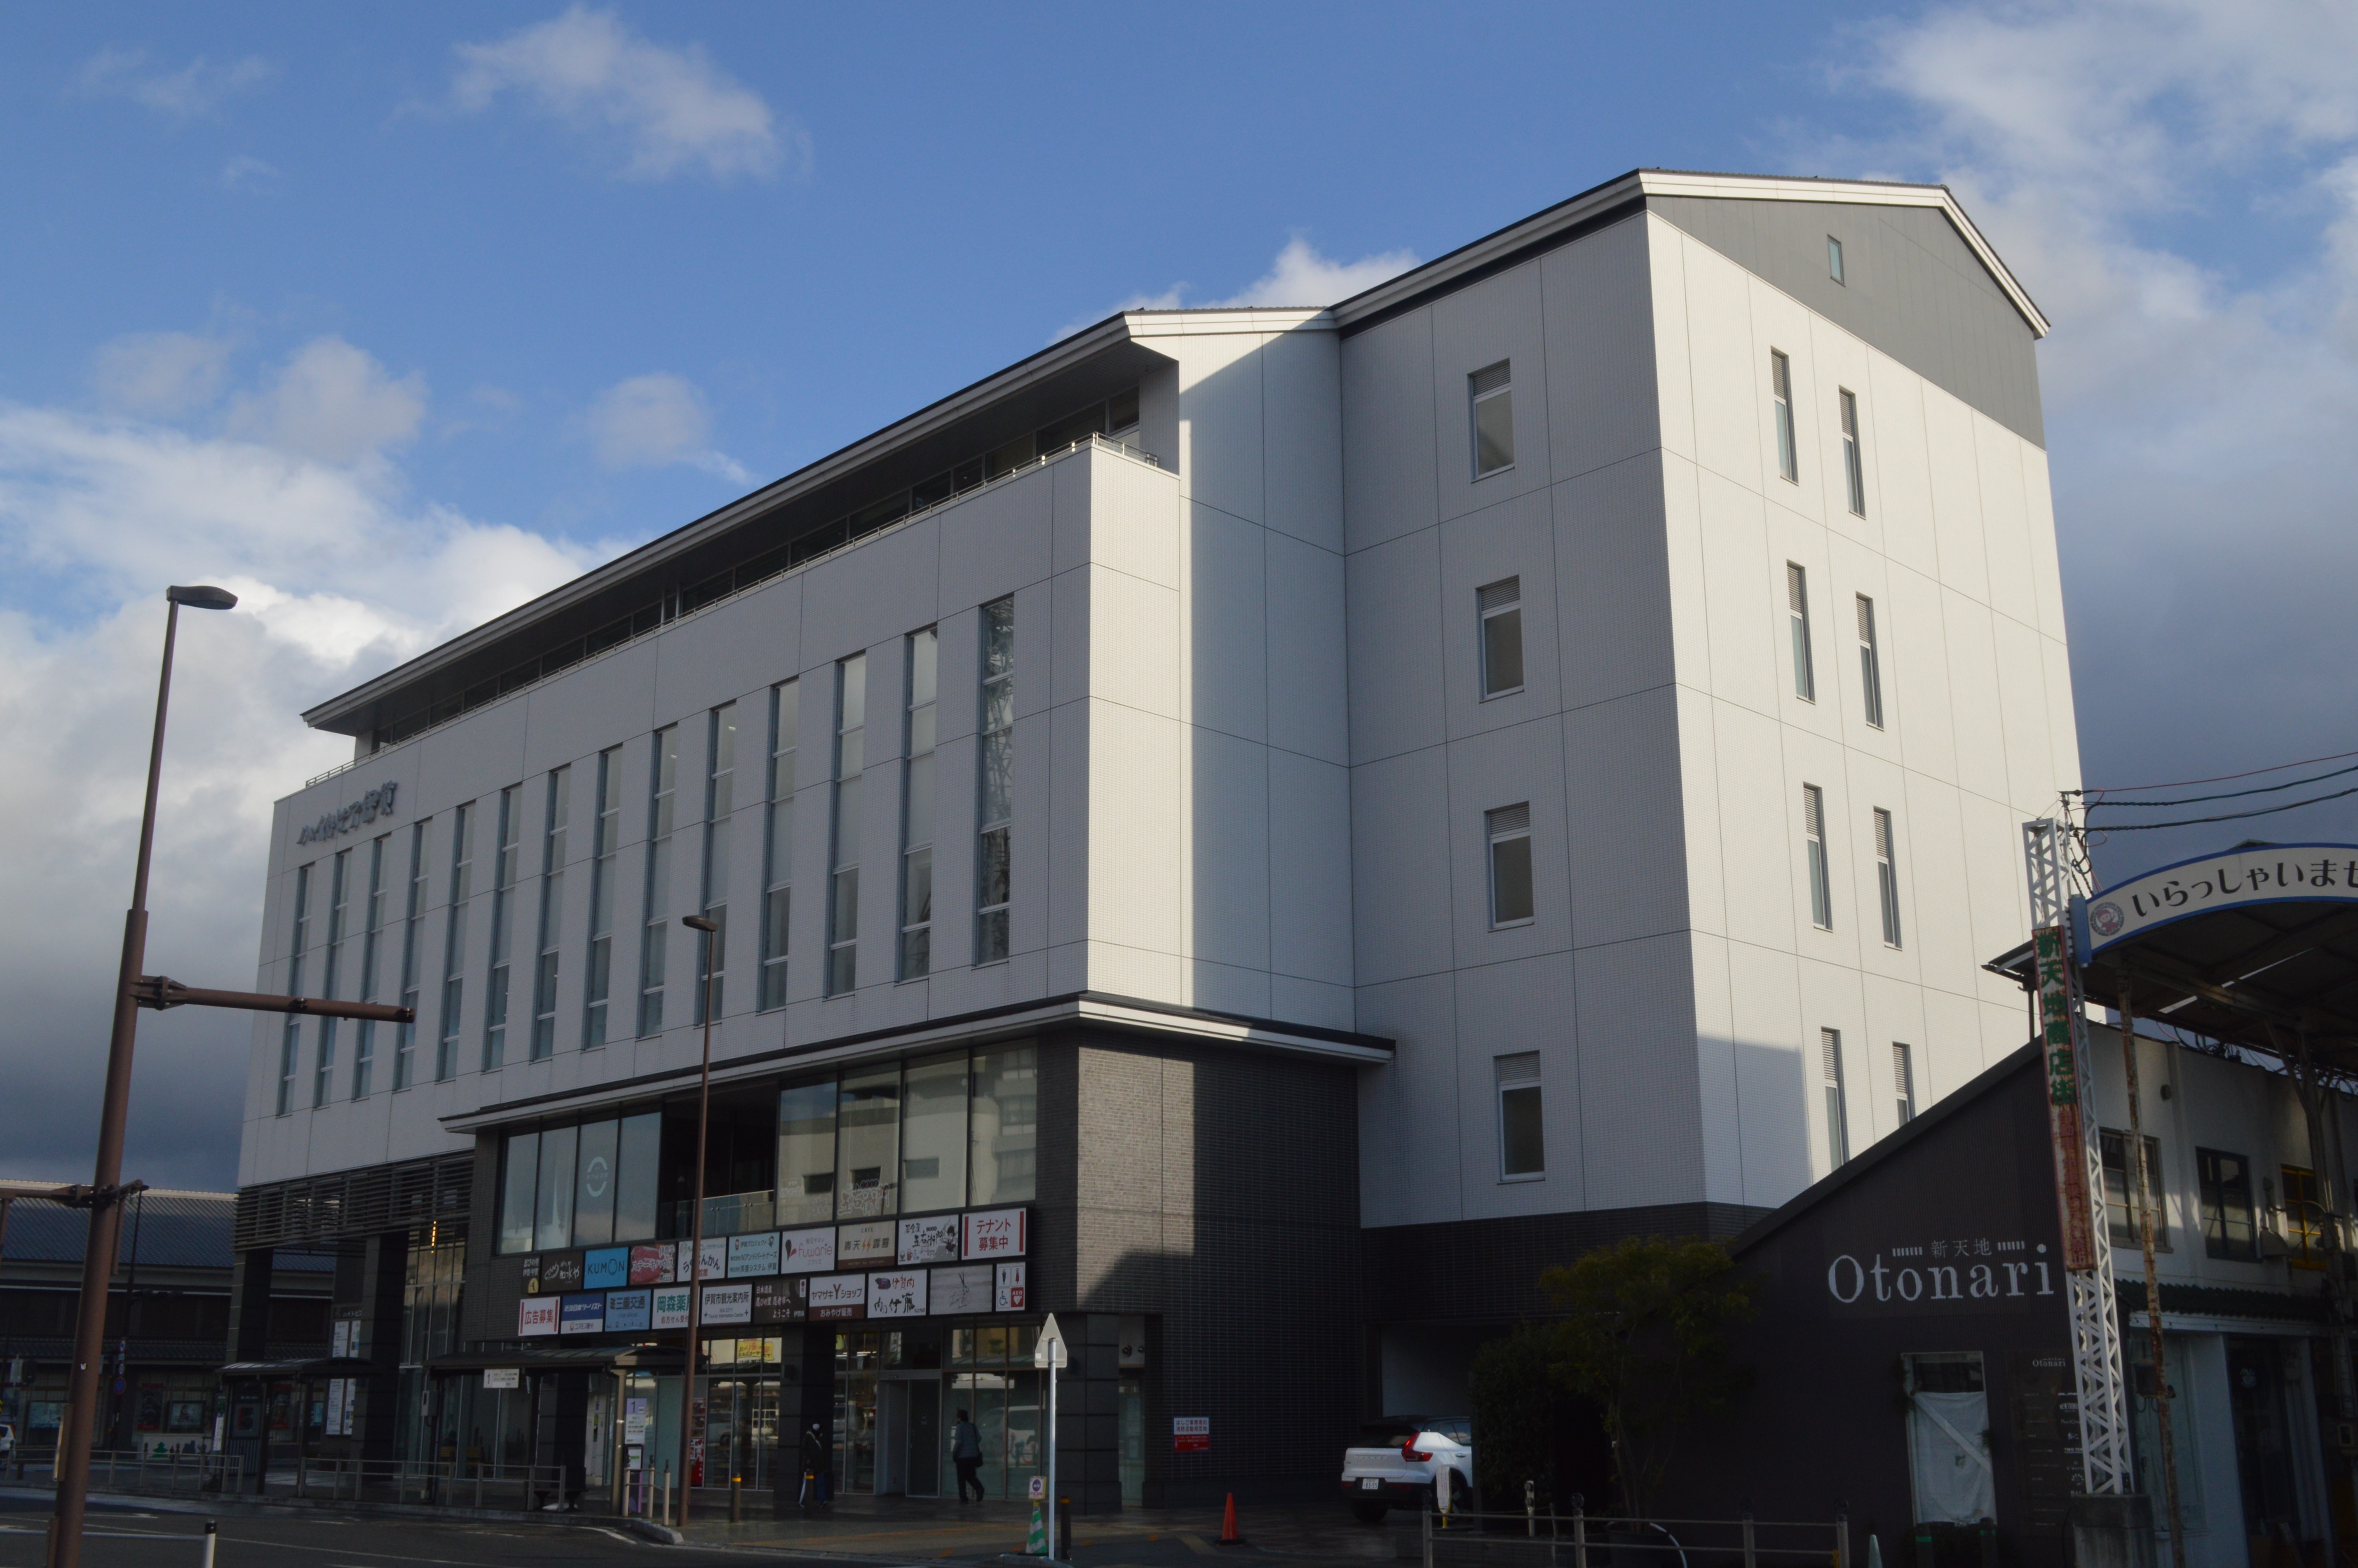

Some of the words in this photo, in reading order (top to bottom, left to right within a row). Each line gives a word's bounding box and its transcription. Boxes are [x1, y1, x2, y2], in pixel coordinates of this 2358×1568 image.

[976, 1218, 1011, 1234] テナント
[798, 1243, 832, 1257] fuwarie
[979, 1235, 1008, 1251] 募集中
[1931, 1238, 1992, 1259] 新天地
[587, 1259, 625, 1275] KUMON
[631, 1258, 674, 1272] ステーキハウス
[683, 1254, 720, 1272] らんかん
[1828, 1244, 2054, 1303] Otonari
[705, 1291, 749, 1305] 伊賀市観光案内所
[812, 1284, 862, 1300] ヤマザキYショップ
[564, 1303, 602, 1312] 近畿日本ツーリスト
[616, 1296, 645, 1310] 三重交通
[525, 1309, 554, 1325] 広告募集
[773, 1309, 790, 1318] ようこそ
[820, 1308, 852, 1317] おみやげ販売
[2032, 1359, 2066, 1367] Otonari
[631, 1400, 636, 1413] 1
